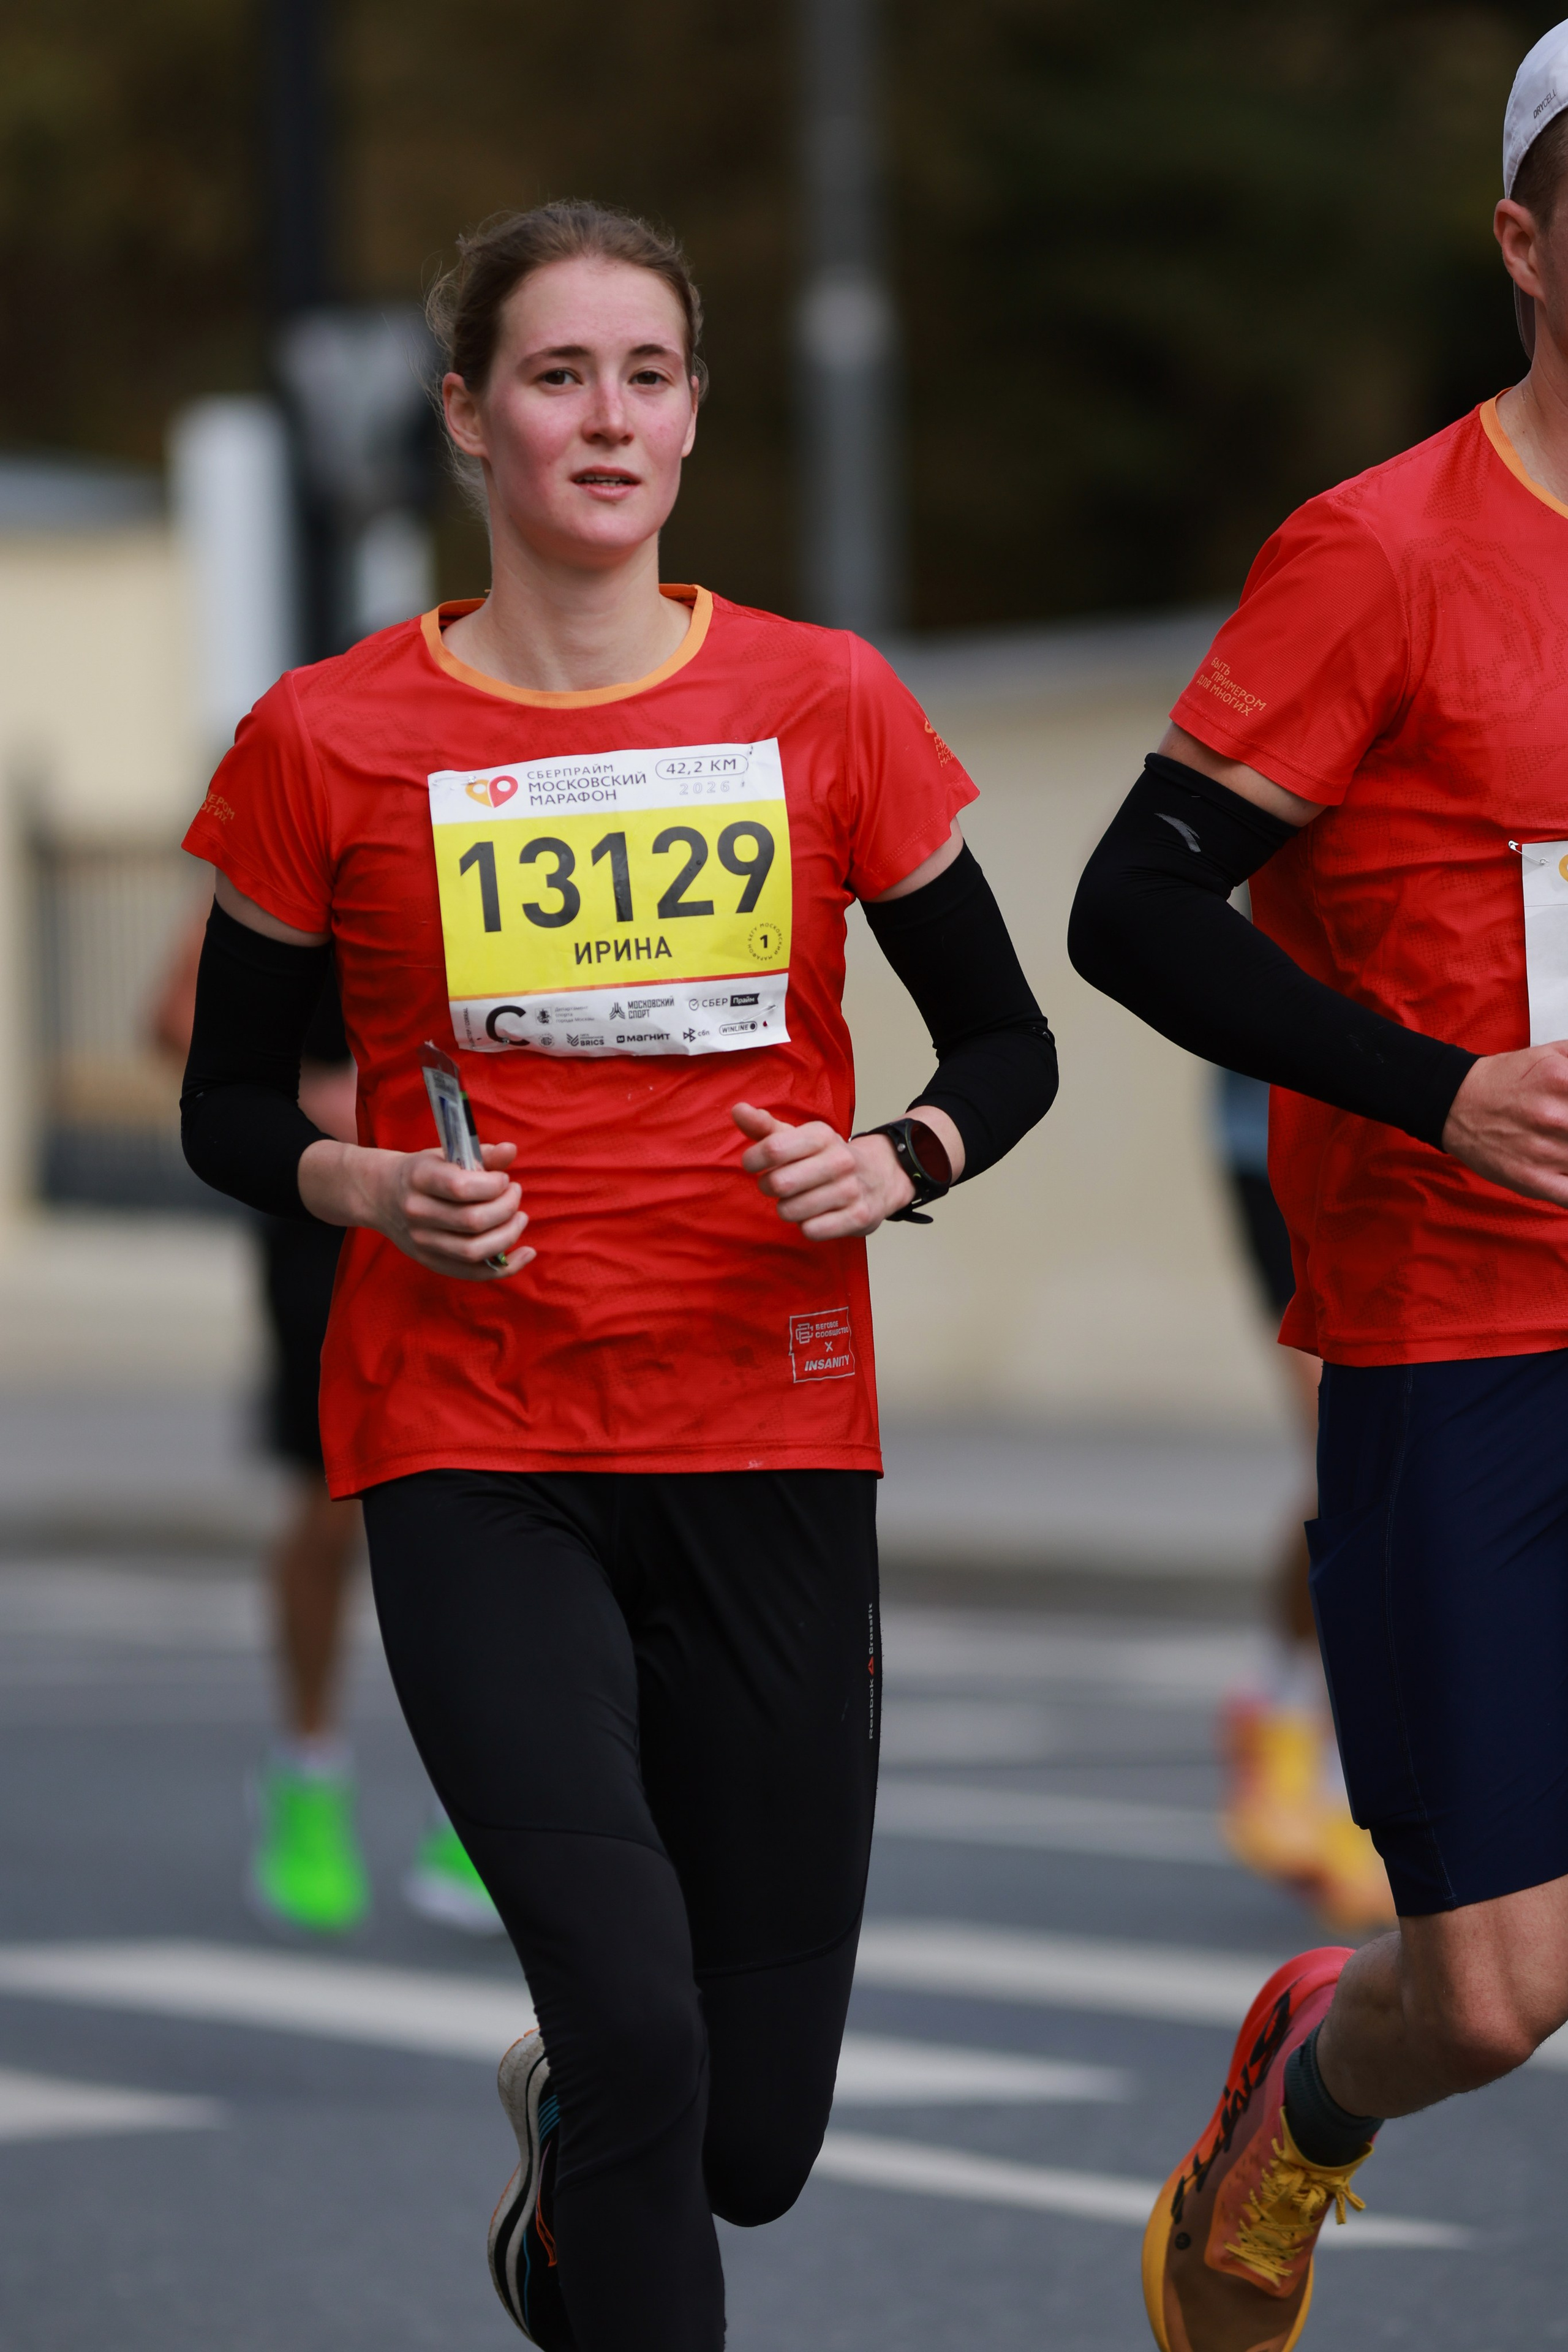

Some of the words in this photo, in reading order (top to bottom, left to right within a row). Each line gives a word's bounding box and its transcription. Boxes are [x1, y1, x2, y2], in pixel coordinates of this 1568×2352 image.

[1533, 89, 1556, 119] DRYCELL
[1211, 657, 1231, 676] БЫТЬ
[1196, 674, 1212, 690] ДЛЯ
[1210, 684, 1254, 717] МНОГИХ
[1210, 671, 1267, 711] ПРИМЕРОМ
[527, 764, 614, 780] СБЕРПРАЙМ
[666, 761, 703, 775] 42,2
[710, 758, 737, 772] КМ
[528, 771, 647, 793] МОСКОВСКИЙ
[679, 780, 730, 796] 2026
[530, 789, 617, 806] МАРАФОН
[459, 820, 775, 933] 13129
[760, 934, 767, 949] 1
[574, 936, 673, 965] ИРИНА
[627, 995, 674, 1009] МОСКОВСКИЙ
[702, 998, 728, 1008] СБЕР
[733, 996, 755, 1005] Прайм
[628, 1009, 650, 1019] СПОРТ
[722, 1023, 749, 1033] WINLINE
[626, 1033, 671, 1042] магнит
[815, 1320, 839, 1330] БЕГОВОЕ
[815, 1326, 849, 1338] СООБЩЕСТВО
[804, 1354, 850, 1371] INSANITY
